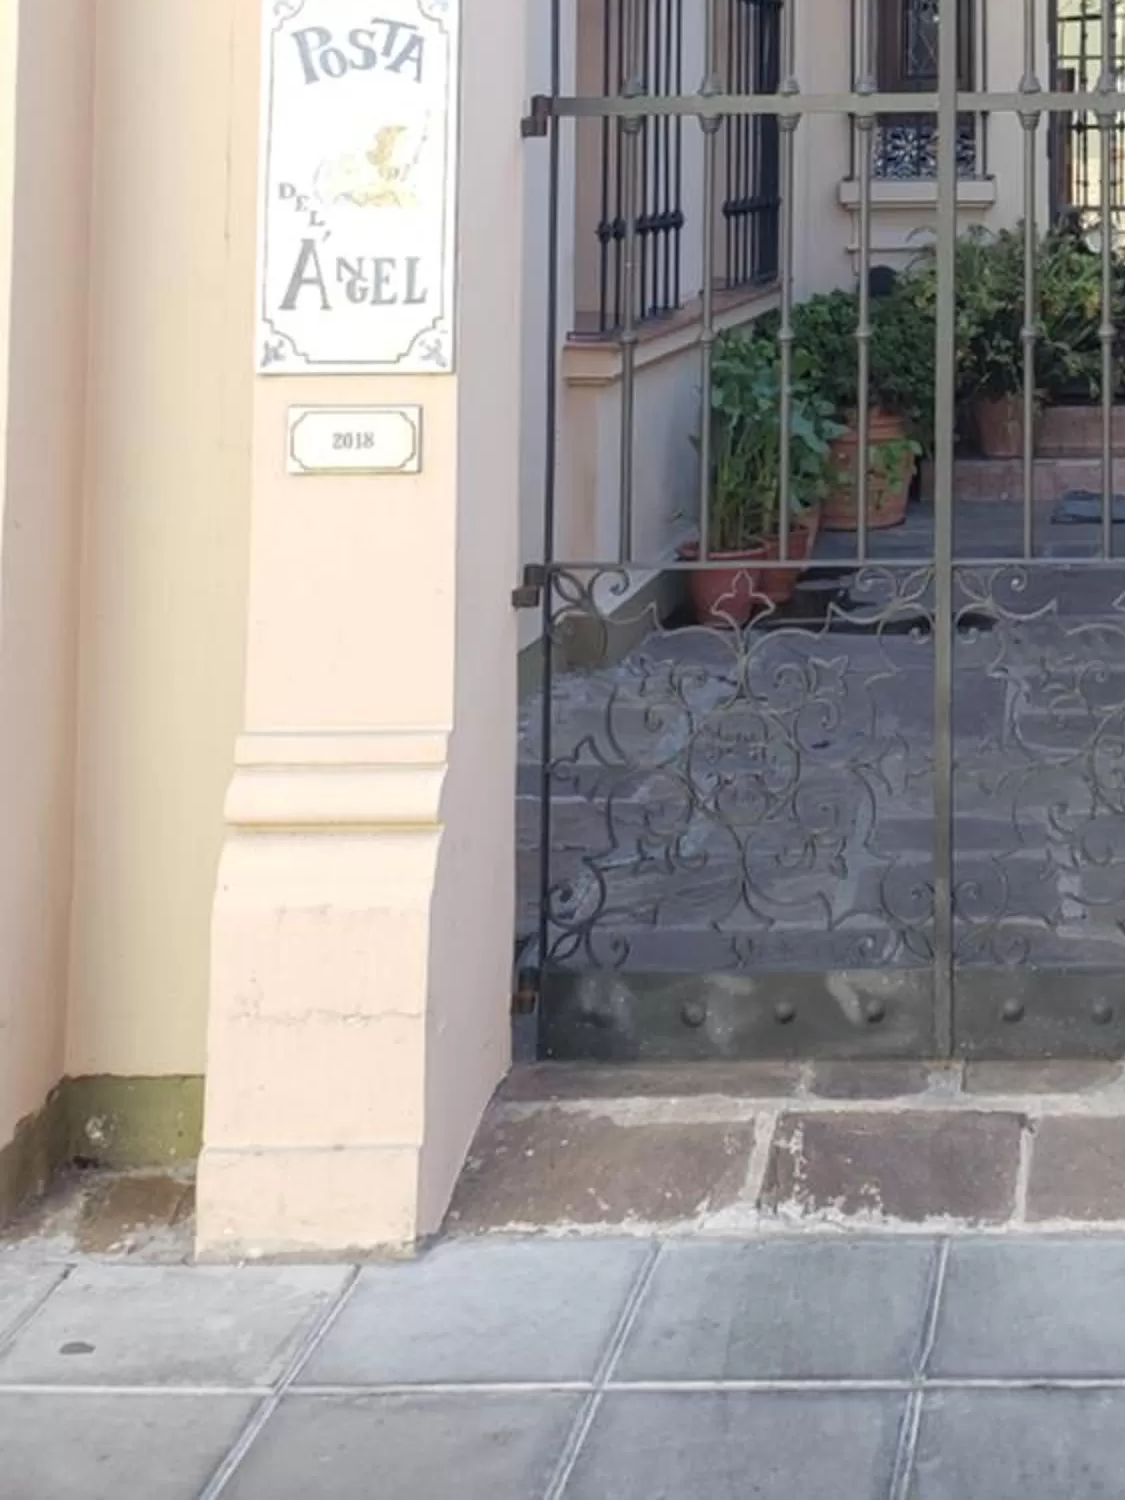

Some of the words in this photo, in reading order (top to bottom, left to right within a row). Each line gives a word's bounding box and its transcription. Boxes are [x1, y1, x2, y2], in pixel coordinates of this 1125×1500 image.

[291, 17, 425, 85] POSTA
[278, 182, 326, 228] DEL
[331, 431, 376, 451] 2018
